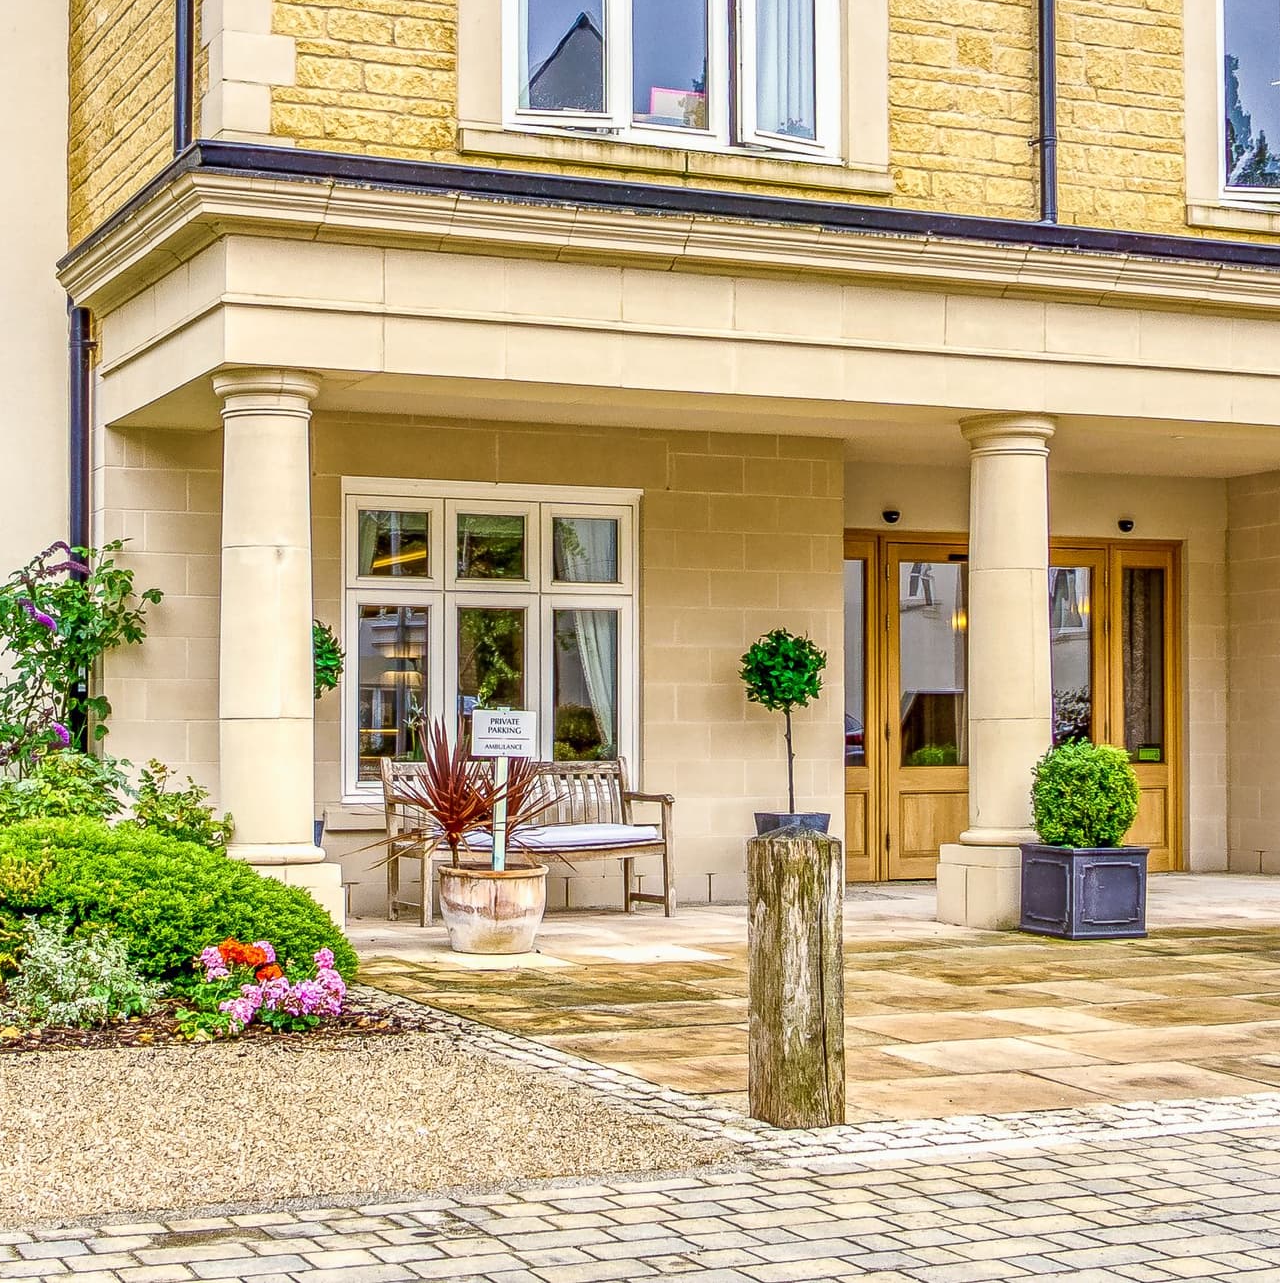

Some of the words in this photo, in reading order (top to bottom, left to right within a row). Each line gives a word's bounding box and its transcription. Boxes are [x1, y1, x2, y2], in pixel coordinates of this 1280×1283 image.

[490, 717, 520, 726] PRIVATE
[487, 726, 522, 735] PARKING
[484, 743, 522, 751] AMBULANCE
